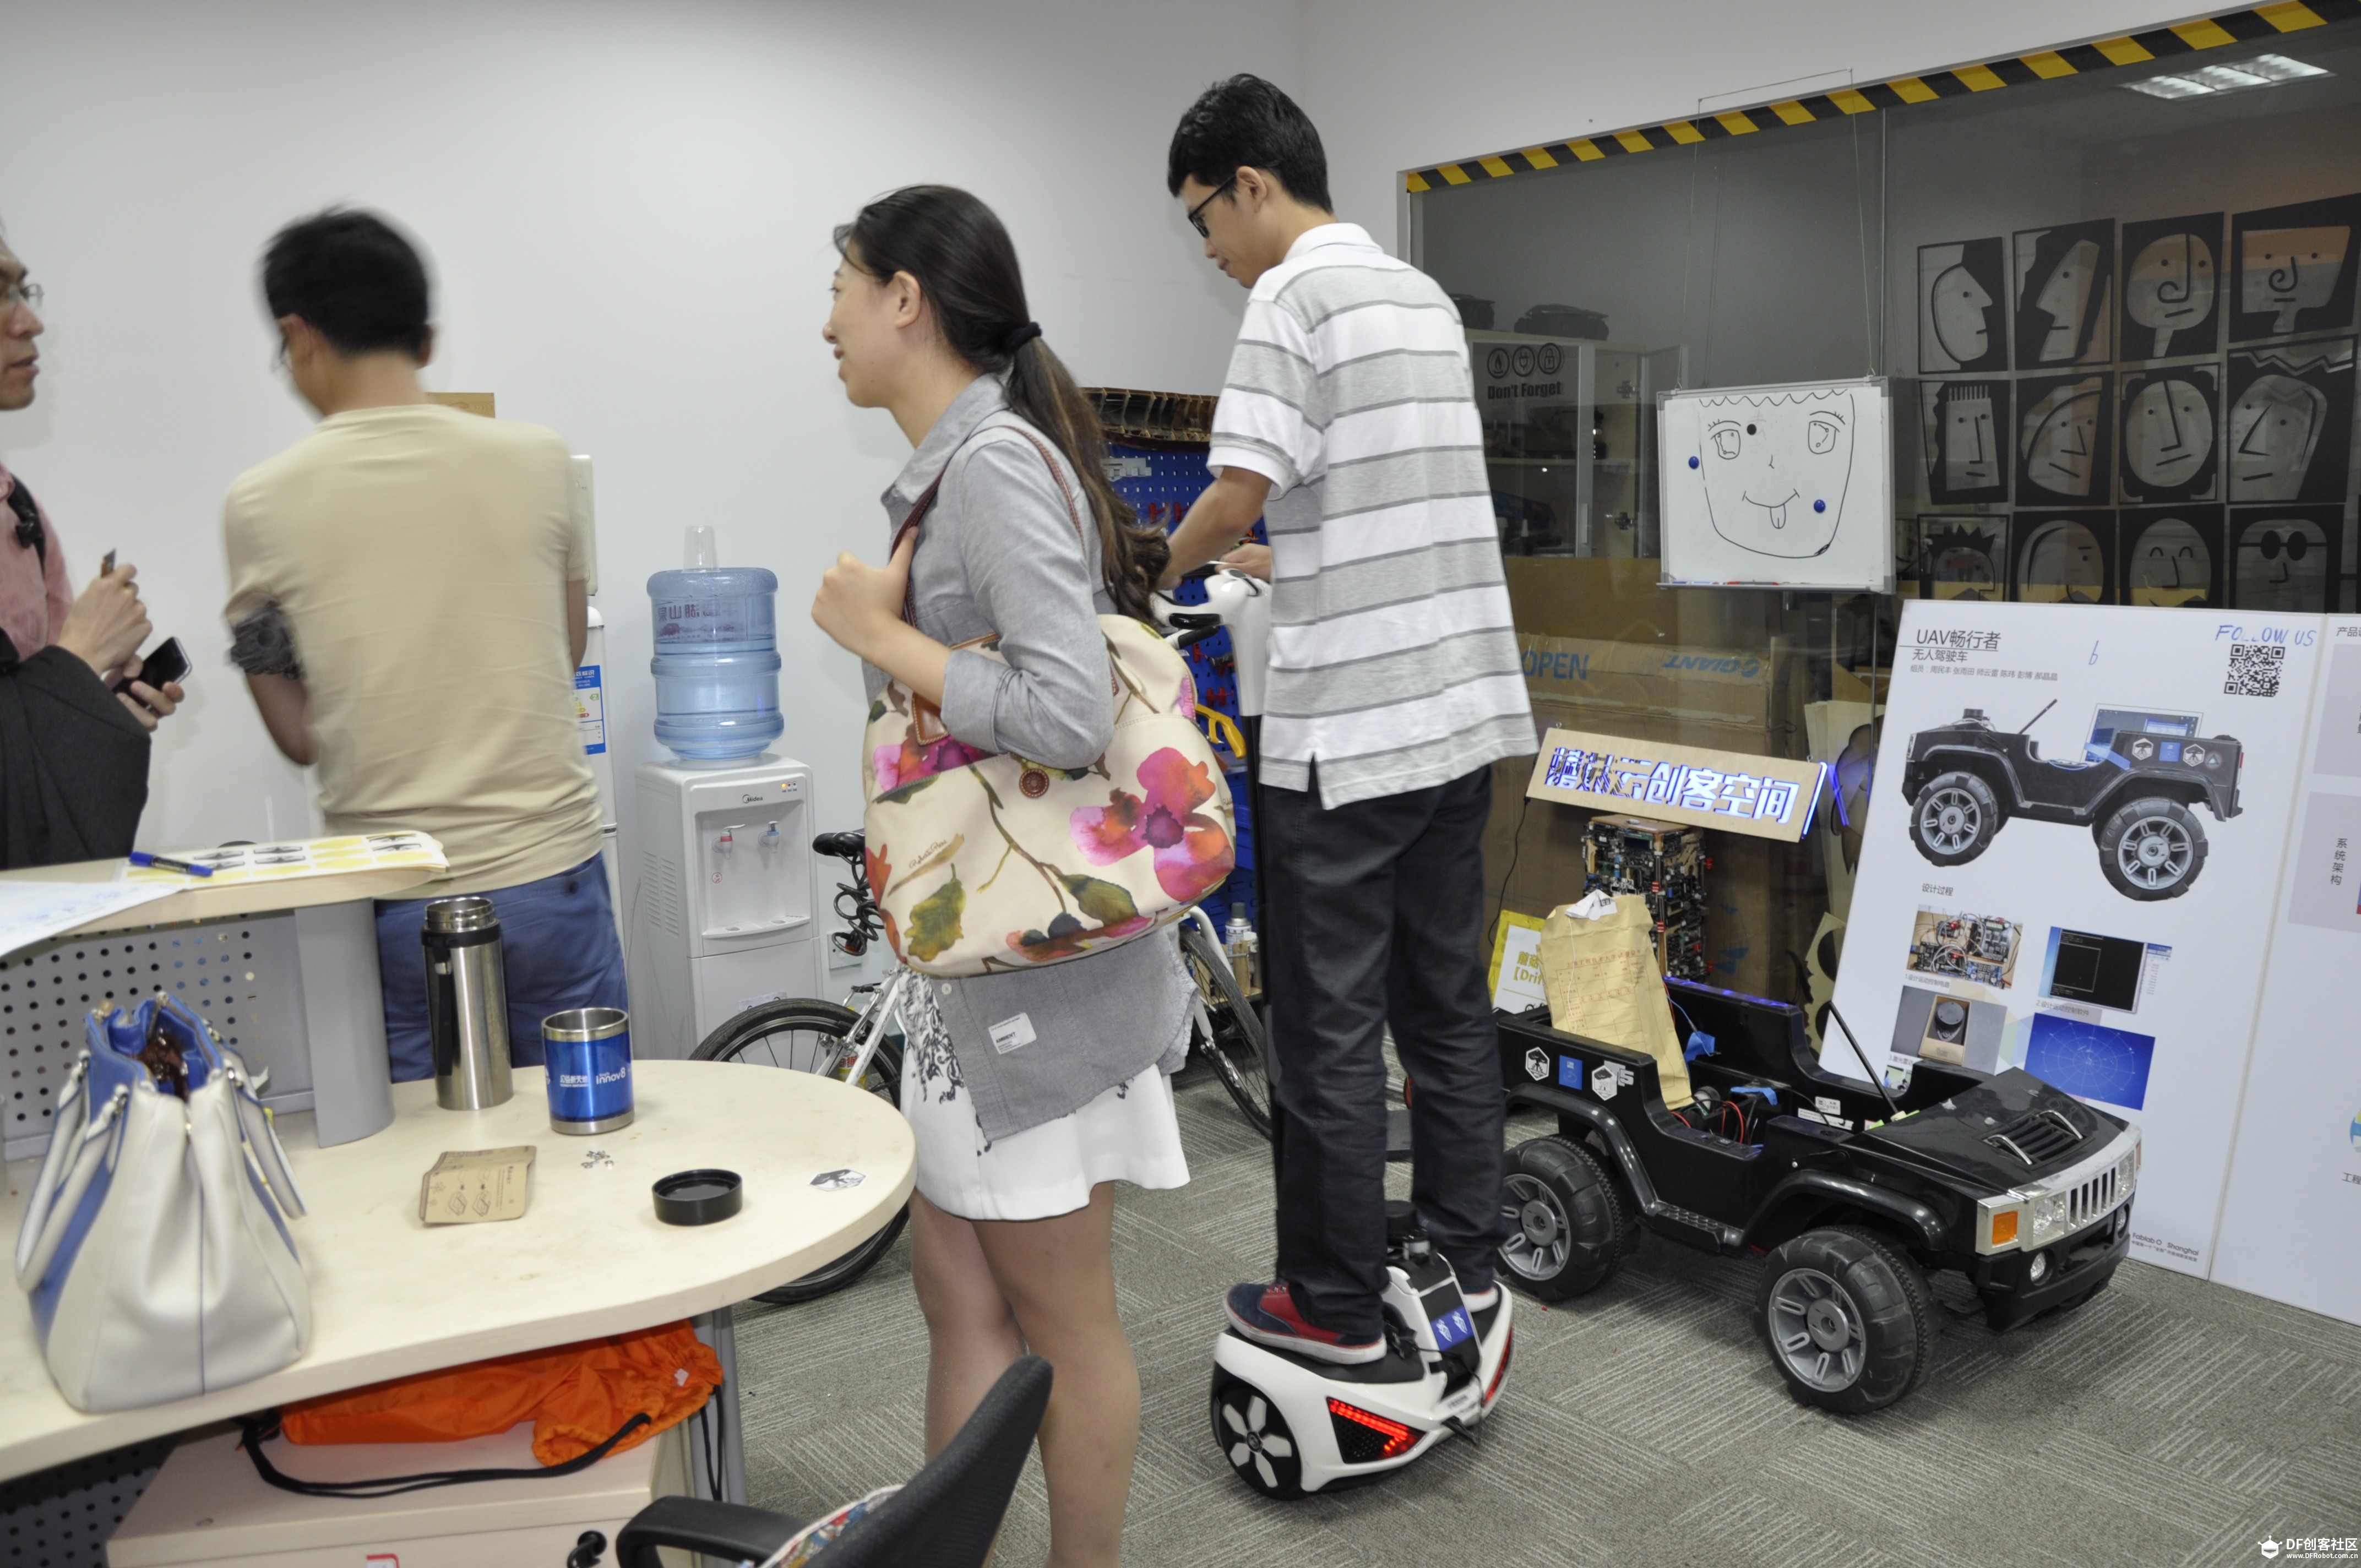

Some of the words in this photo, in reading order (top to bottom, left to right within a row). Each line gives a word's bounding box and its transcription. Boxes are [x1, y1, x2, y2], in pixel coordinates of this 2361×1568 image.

[1488, 384, 1519, 400] Don't
[1521, 381, 1562, 398] Forget
[1916, 629, 2001, 650] UAV畅行者
[2294, 629, 2317, 647] US
[2336, 627, 2361, 638] 产品
[1662, 654, 1742, 674] GIANT
[1912, 649, 1968, 663] 无人驾驶车
[1521, 651, 1590, 680] OPEN
[742, 794, 763, 804] Midea
[2330, 838, 2348, 885] 系统架构
[1921, 883, 1954, 897] 设计过程
[995, 1031, 1016, 1044] AMBIENT
[2132, 1232, 2155, 1244] Fablab
[2167, 1242, 2199, 1256] Shanghai
